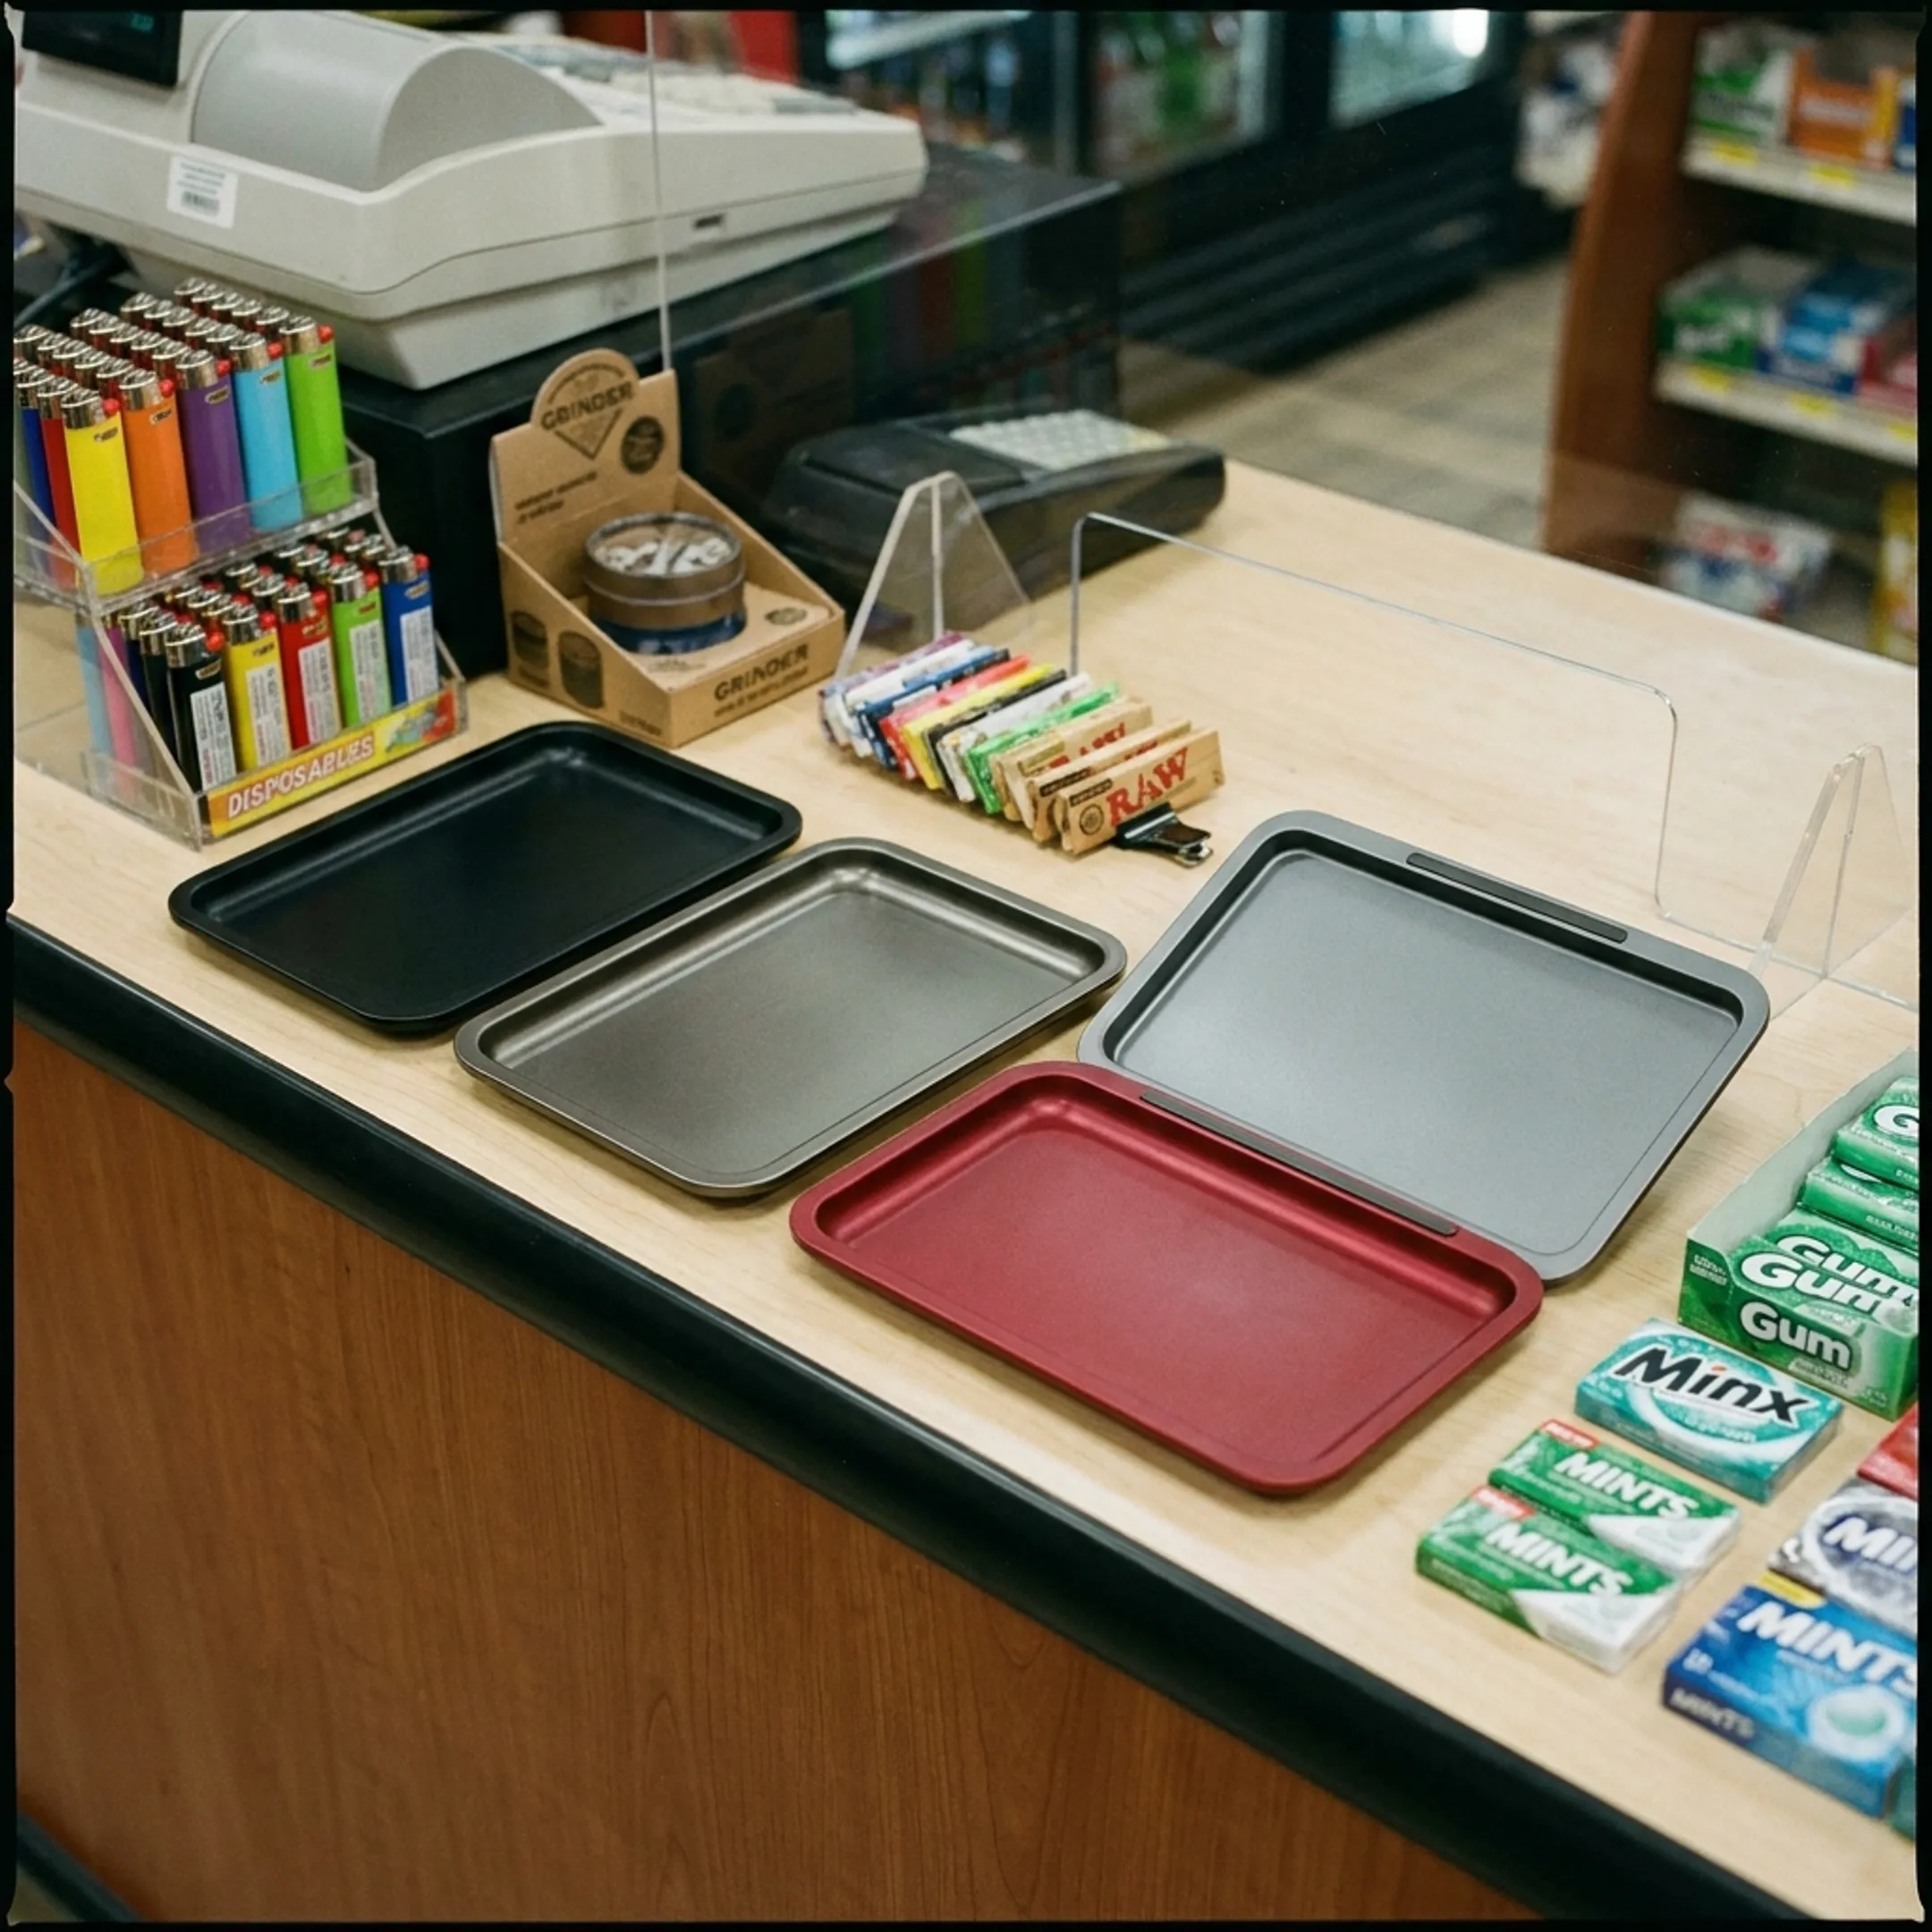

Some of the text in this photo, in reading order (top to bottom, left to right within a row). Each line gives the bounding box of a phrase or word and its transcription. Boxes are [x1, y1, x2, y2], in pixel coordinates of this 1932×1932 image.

[714, 643, 809, 701] GRINDER
[228, 735, 374, 819] DISPOSABLES
[1106, 746, 1189, 827] RAW
[1741, 1252, 1884, 1315] Gum
[1740, 1301, 1852, 1370] Gum
[1614, 1347, 1810, 1424] Minx
[1554, 1451, 1699, 1521] MINTS
[1485, 1522, 1633, 1597] MINTS
